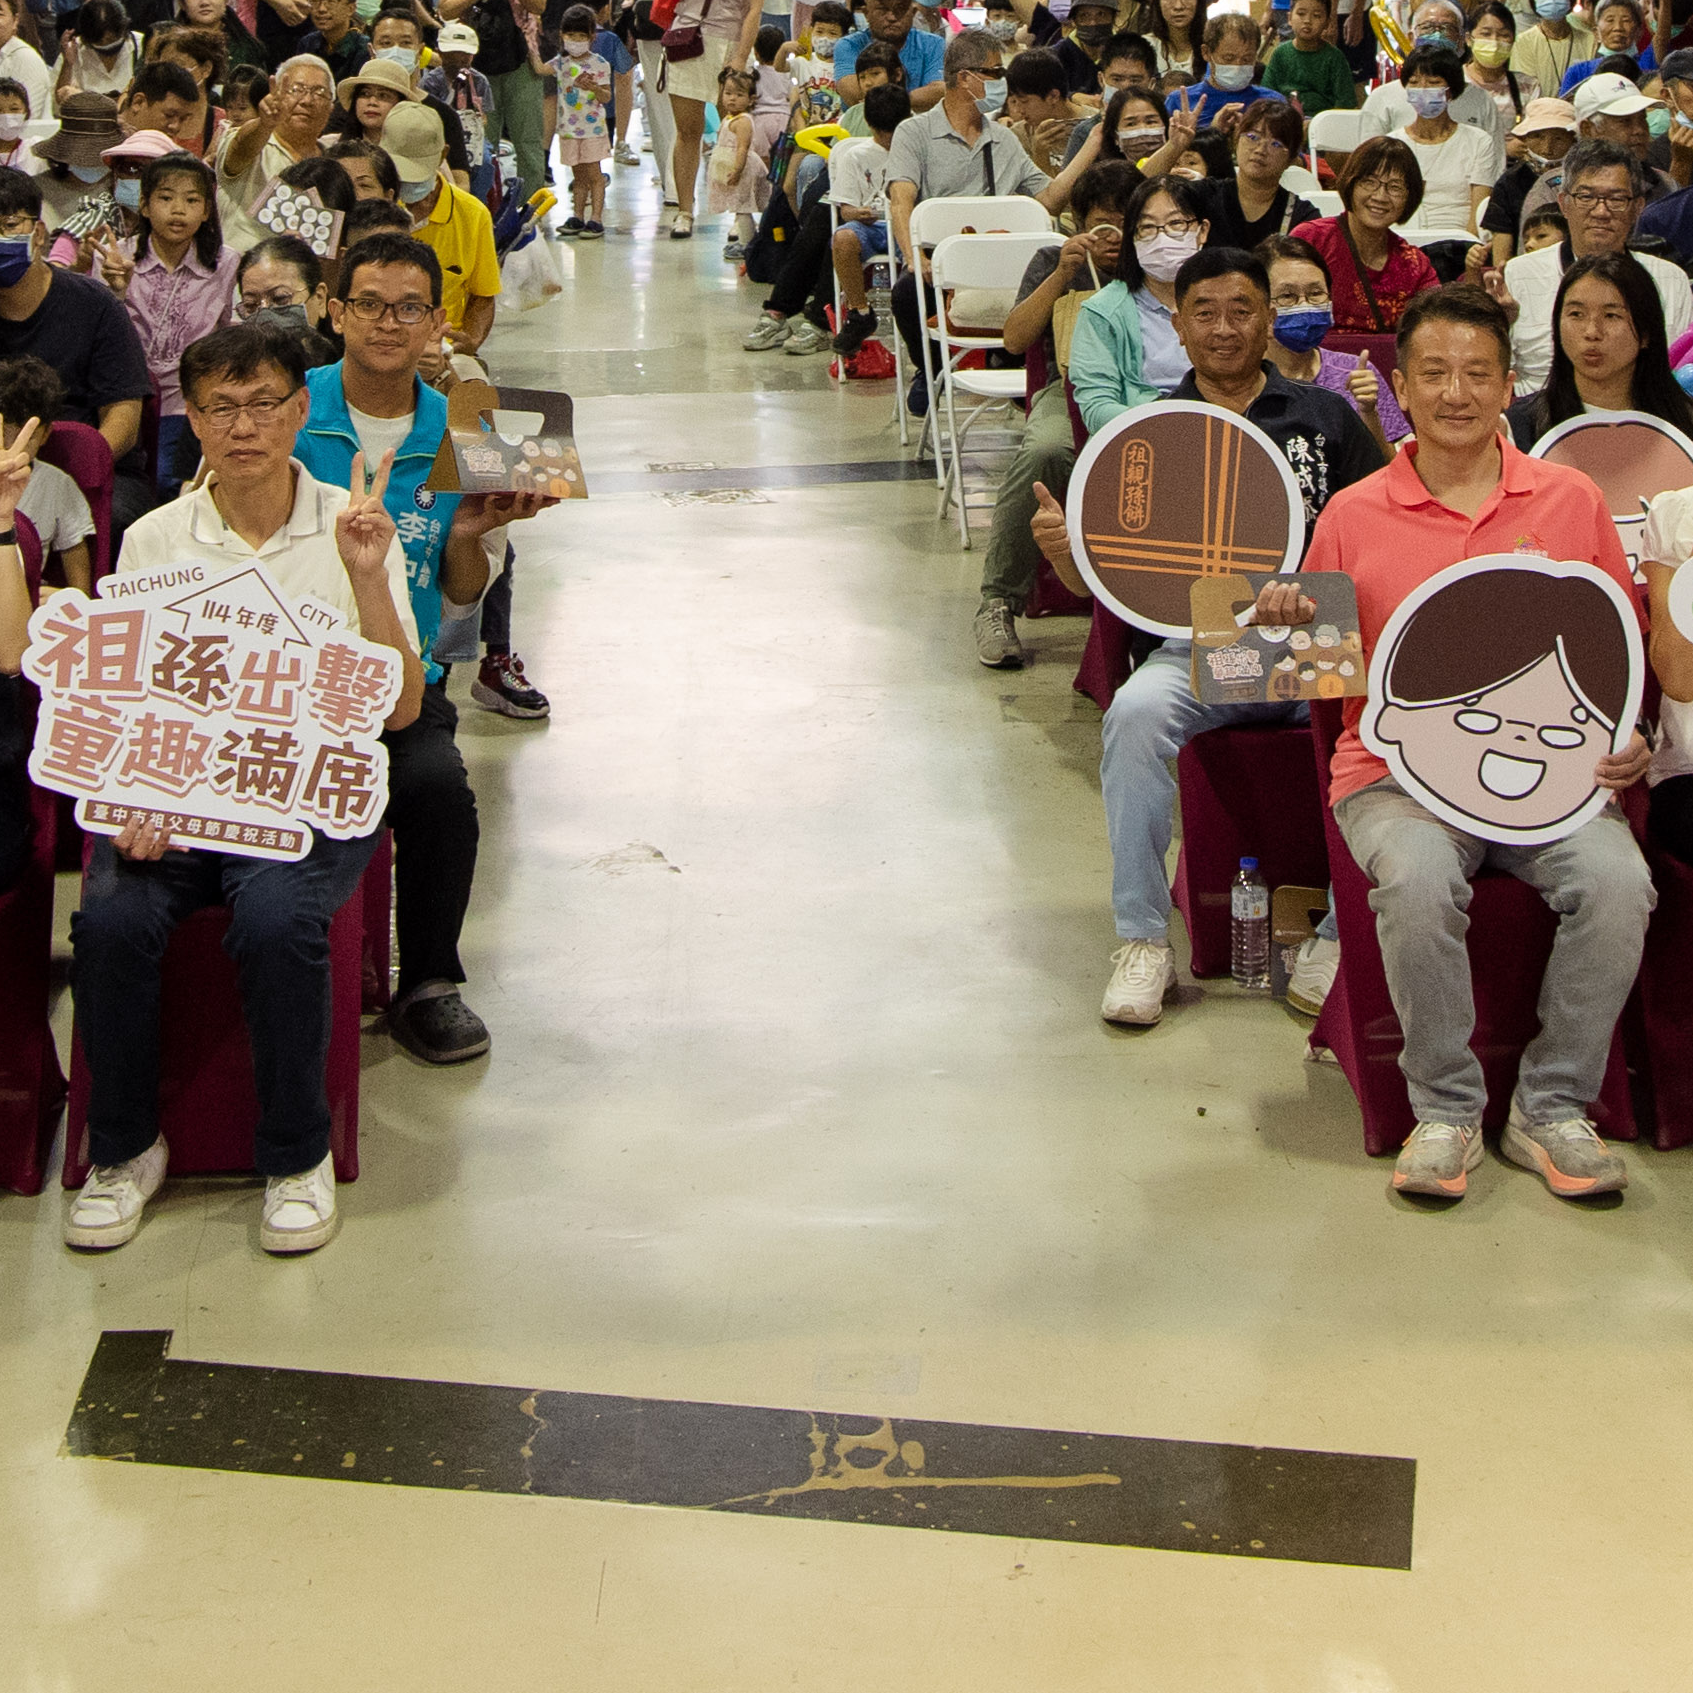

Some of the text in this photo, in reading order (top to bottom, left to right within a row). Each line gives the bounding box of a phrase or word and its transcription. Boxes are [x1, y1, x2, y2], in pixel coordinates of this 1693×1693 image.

[1124, 445, 1149, 527] 祖親孫餅
[106, 565, 339, 632] TAICHUNG CITY
[201, 598, 280, 636] 114年度
[33, 601, 395, 737] 祖孫出擊
[39, 694, 381, 825] 童趣滿席
